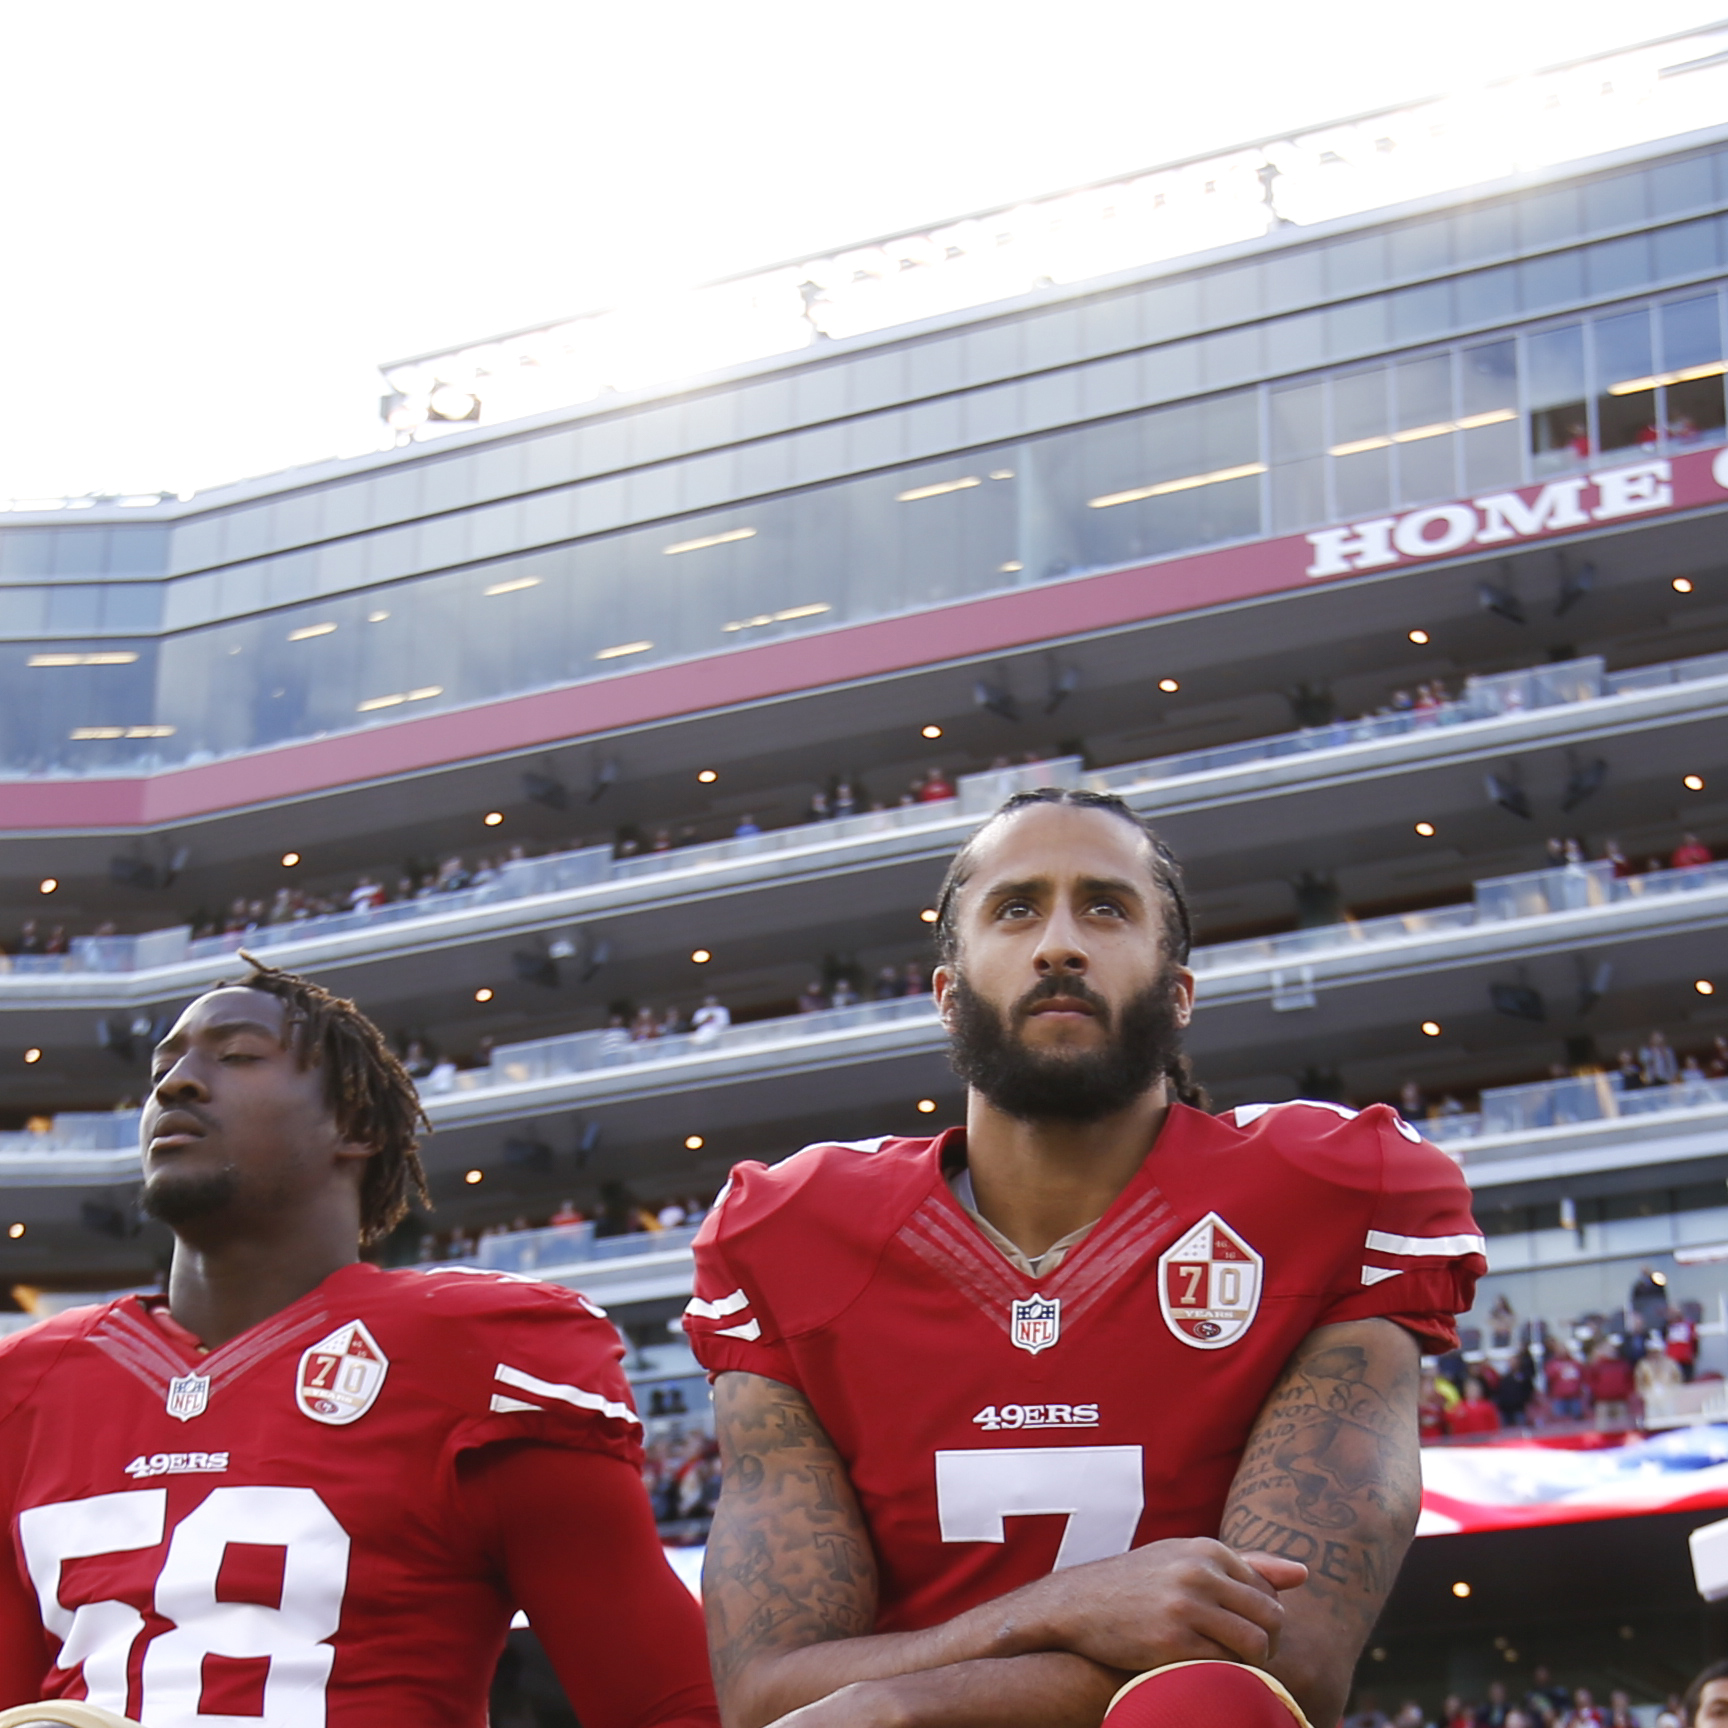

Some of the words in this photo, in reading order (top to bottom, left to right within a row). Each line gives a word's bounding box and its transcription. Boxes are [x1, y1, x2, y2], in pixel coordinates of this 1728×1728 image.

[1305, 457, 1672, 580] HOME
[1179, 1266, 1241, 1306] 70
[1184, 1311, 1234, 1319] YEARS
[1019, 1320, 1052, 1343] NFL
[311, 1355, 367, 1395] 70
[174, 1393, 202, 1413] NFL
[972, 1402, 1100, 1431] 49ERS
[124, 1450, 231, 1480] 49ERS
